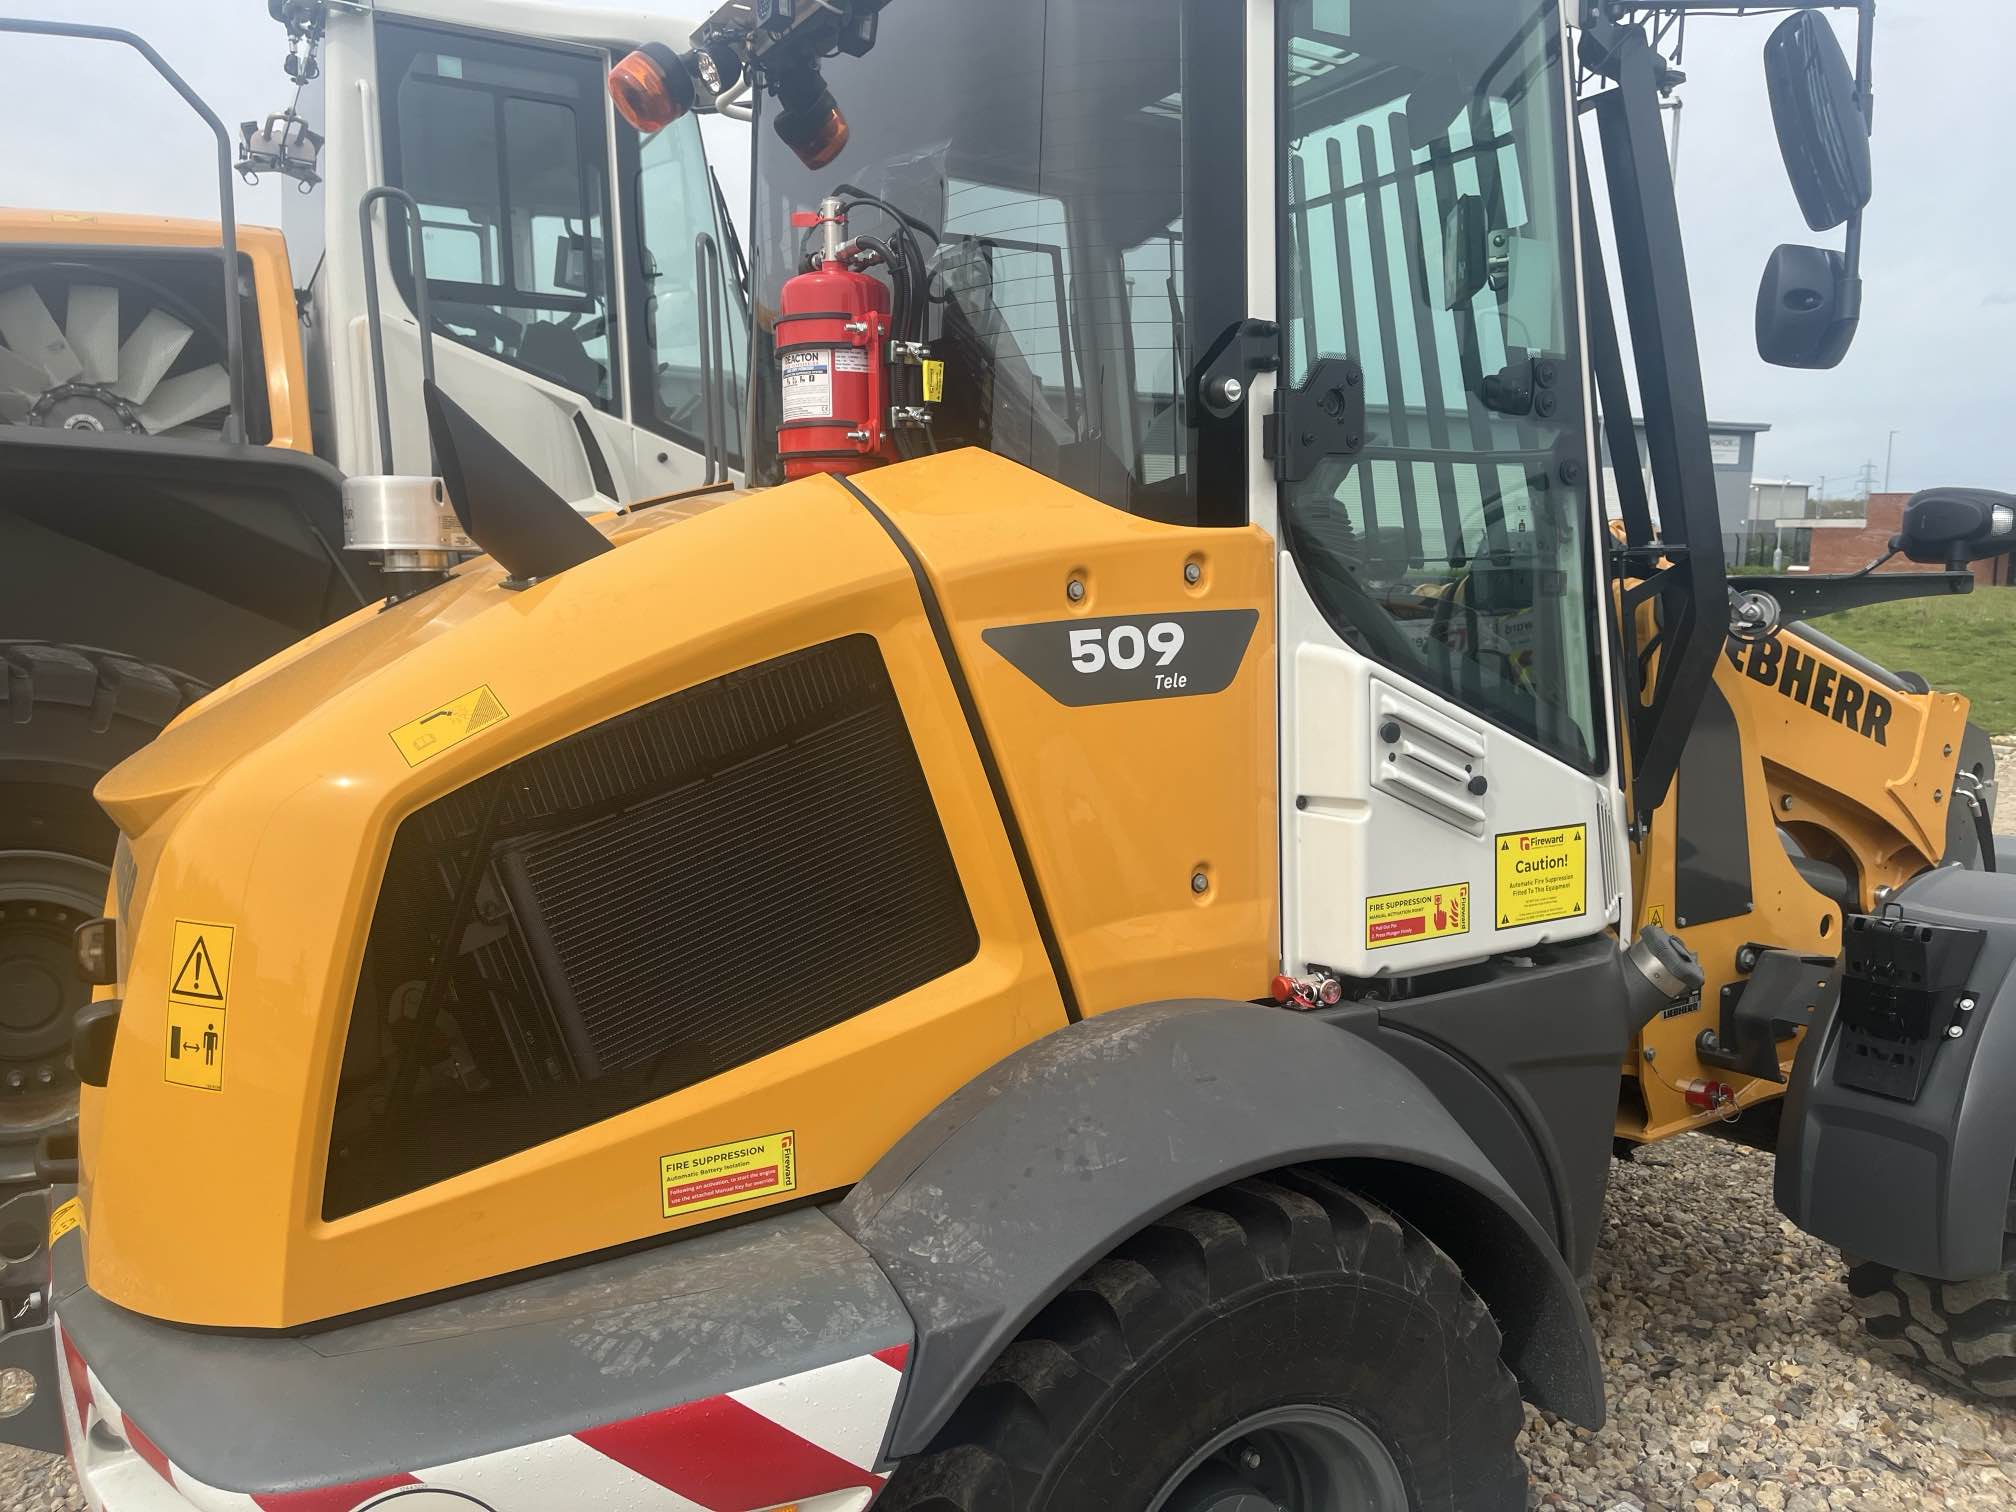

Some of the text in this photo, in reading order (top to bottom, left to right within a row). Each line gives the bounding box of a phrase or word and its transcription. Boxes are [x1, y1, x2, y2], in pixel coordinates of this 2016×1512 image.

[1069, 622, 1185, 674] 509
[1154, 673, 1187, 690] Tele
[1725, 637, 1892, 747] EBHERR
[1531, 834, 1564, 846] Fireward
[1515, 854, 1568, 873] Caution!
[1510, 880, 1533, 889] Automatic
[1545, 875, 1574, 884] Suppression
[1546, 883, 1570, 892] Equipment
[1370, 896, 1432, 911] FIRE SUPPRESSION
[666, 1146, 765, 1173] FIRE SUPPRESSION
[784, 1148, 792, 1186] Fireward
[666, 1161, 750, 1182] Automatic Battery Isolation
[670, 1186, 695, 1195] Following
[703, 1179, 729, 1189] activation,
[759, 1169, 776, 1177] engine
[692, 1191, 714, 1199] attached
[715, 1187, 734, 1195] Manual
